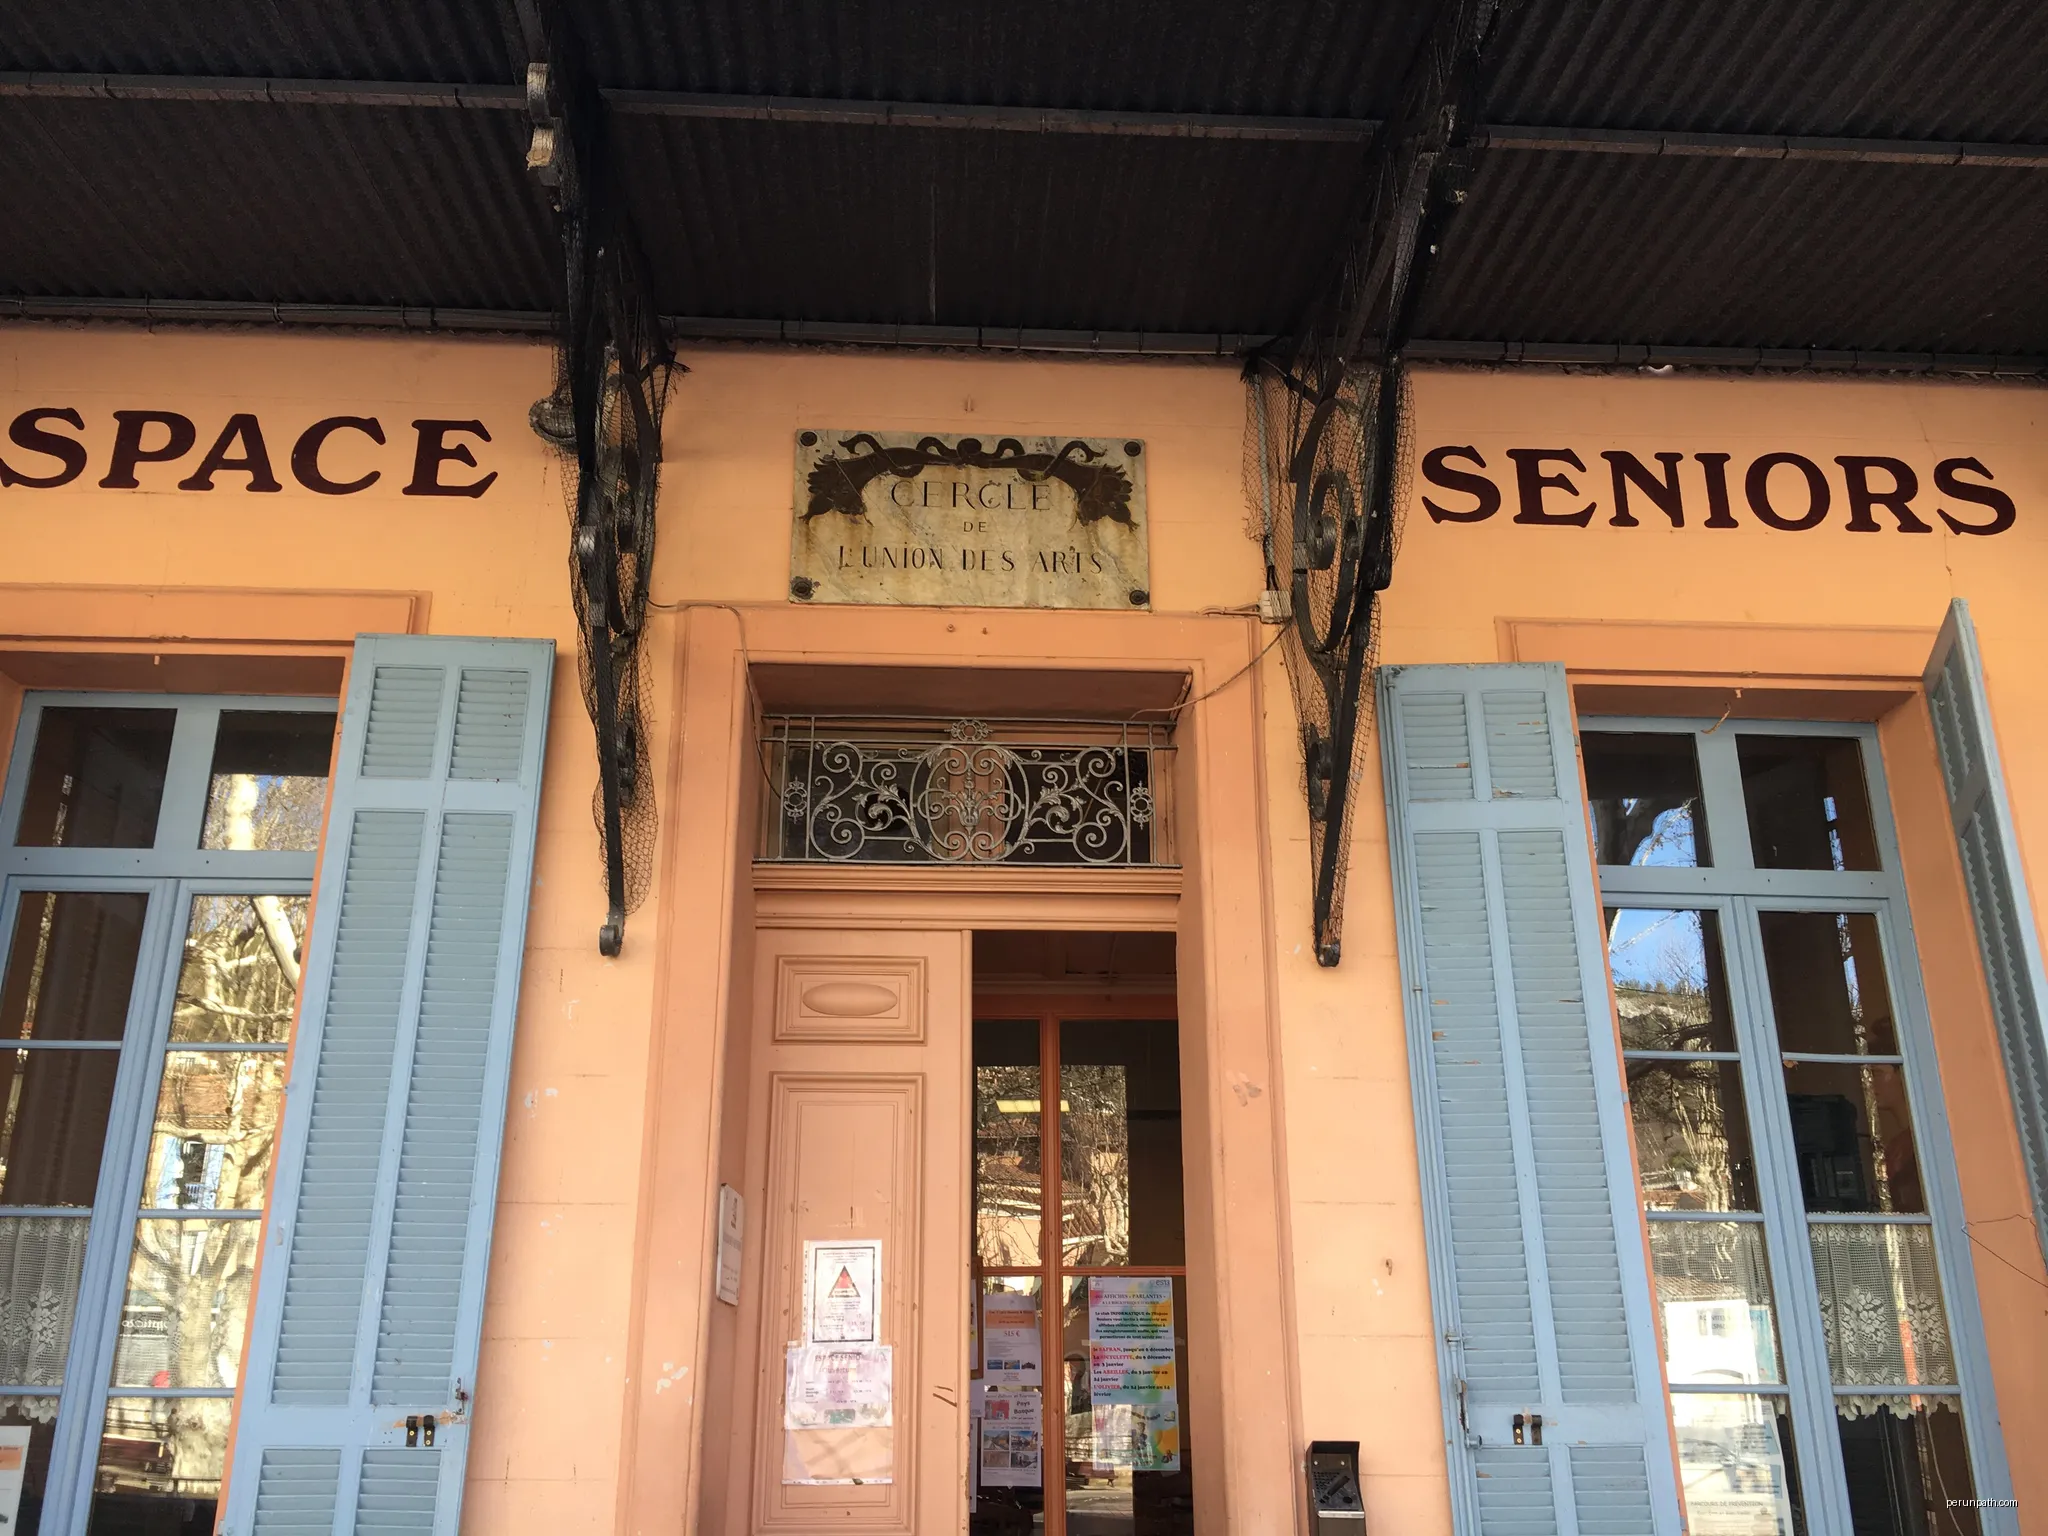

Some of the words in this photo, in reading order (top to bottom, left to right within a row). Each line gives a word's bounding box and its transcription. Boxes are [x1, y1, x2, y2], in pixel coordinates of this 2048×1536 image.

[0, 407, 498, 499] SPACE
[891, 480, 1051, 512] CERCLE
[1421, 445, 2016, 536] SENIORS
[962, 520, 988, 534] DE
[962, 548, 1016, 572] DES
[1030, 550, 1103, 575] ARTS
